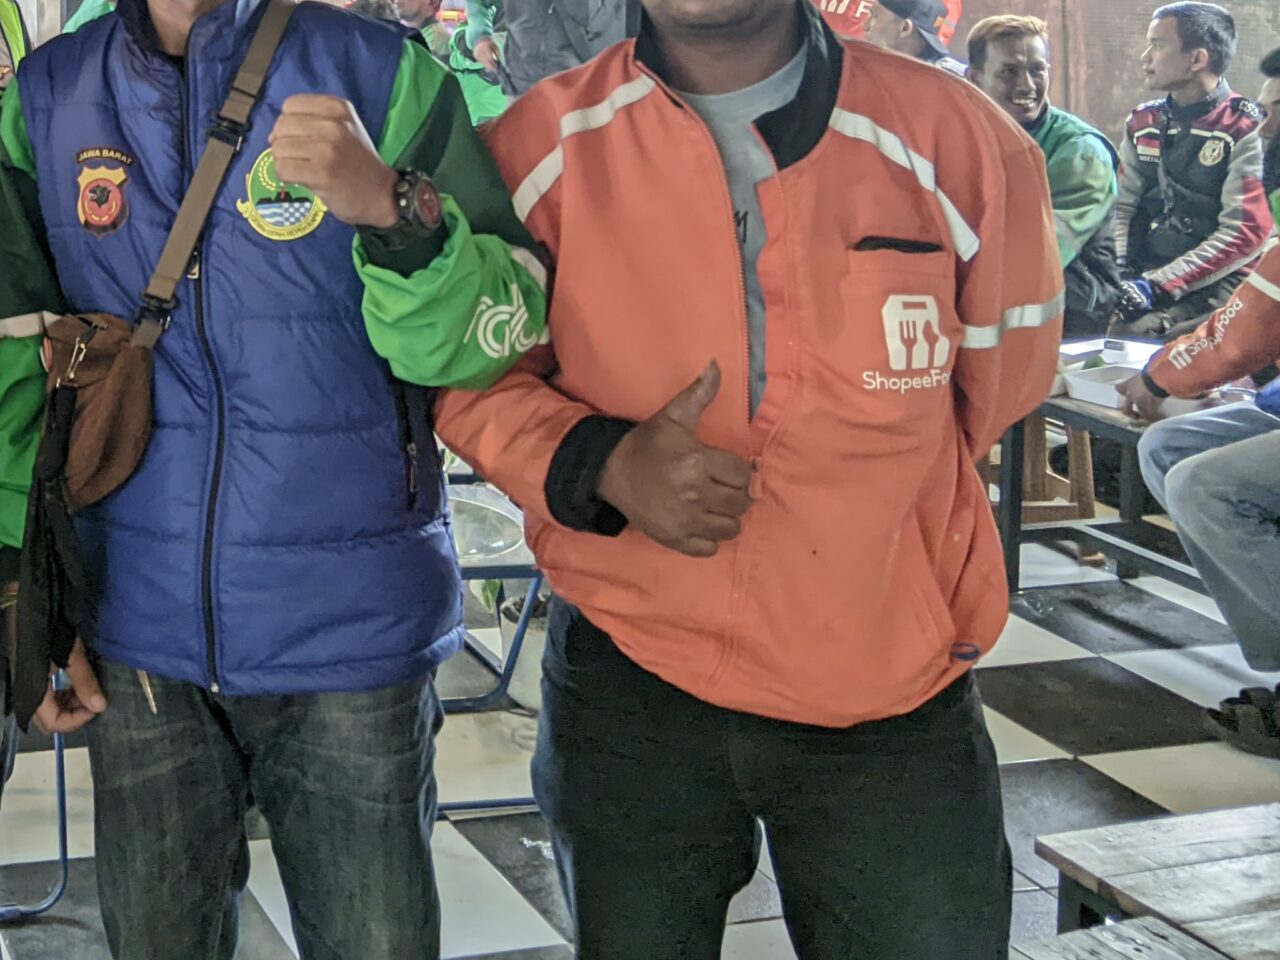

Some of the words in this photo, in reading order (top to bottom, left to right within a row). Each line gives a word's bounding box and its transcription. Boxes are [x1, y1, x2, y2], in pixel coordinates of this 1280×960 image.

[78, 149, 101, 161] JAWA
[102, 149, 132, 164] BARAT
[862, 368, 951, 395] ShopeeFo
